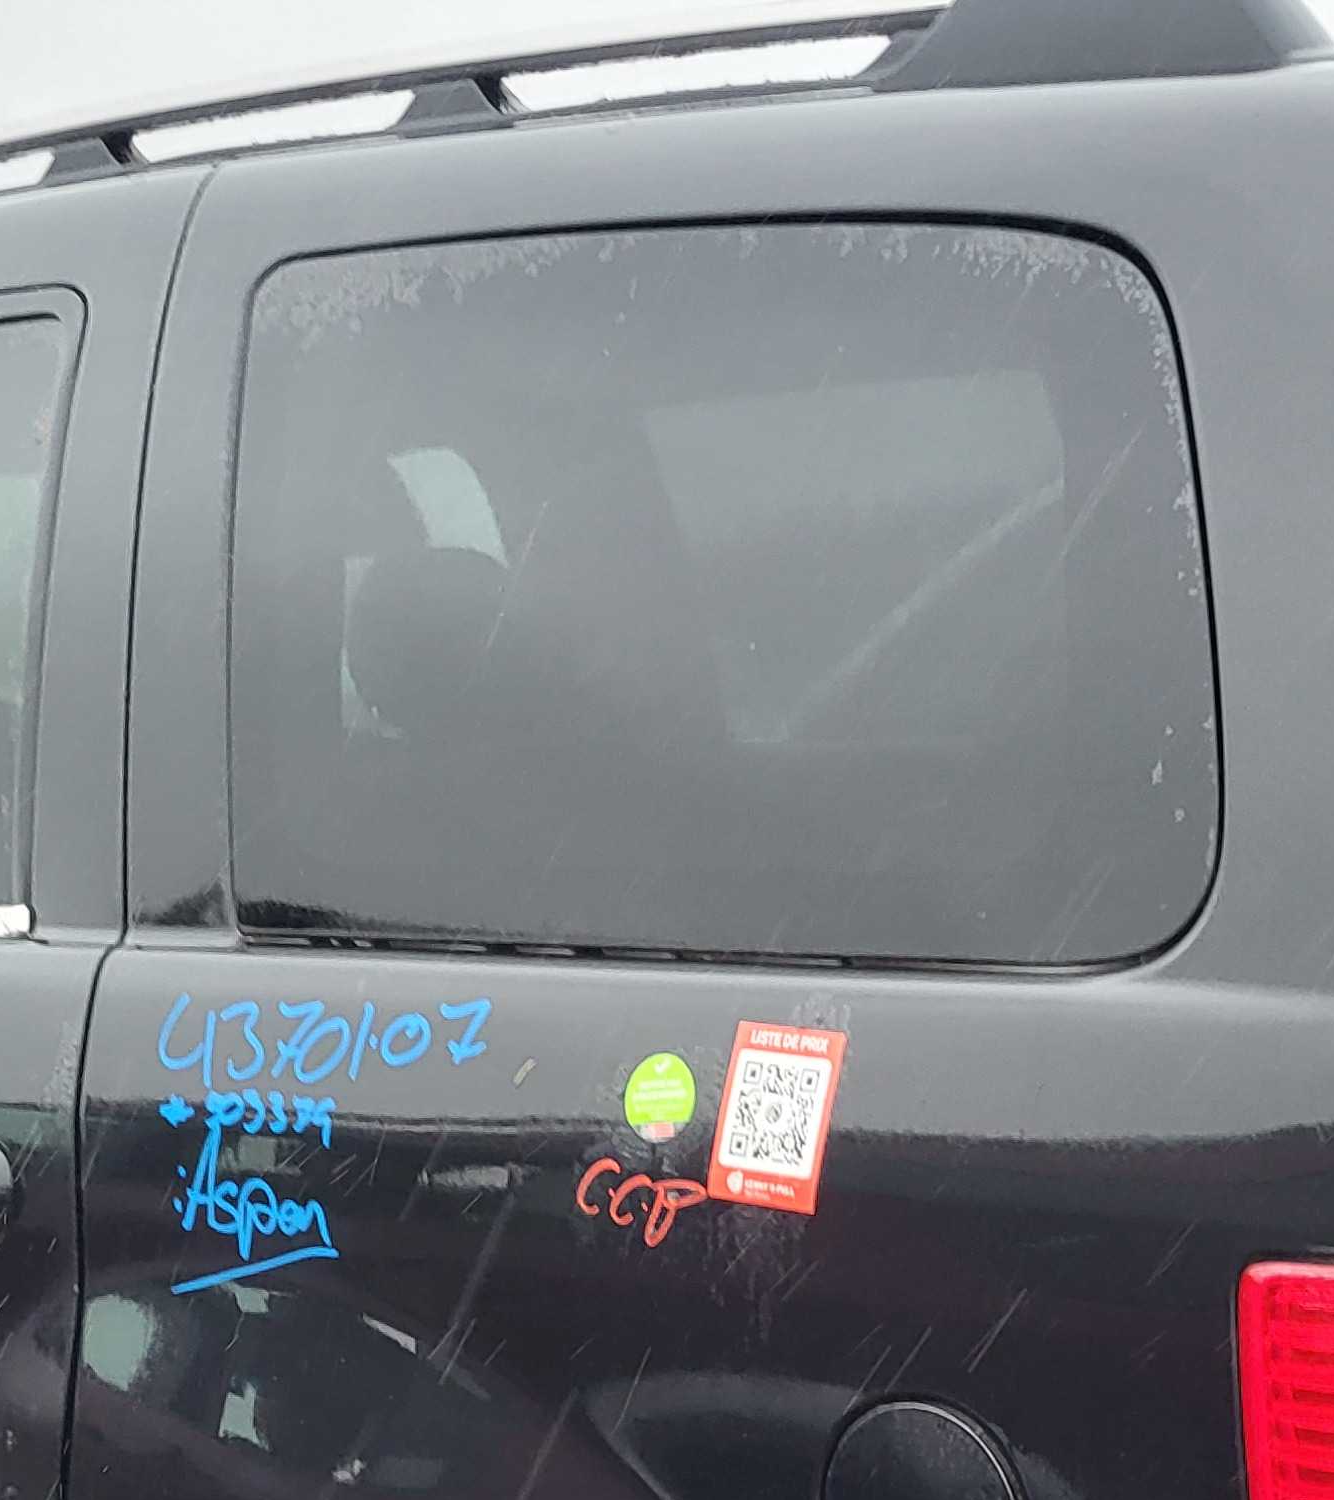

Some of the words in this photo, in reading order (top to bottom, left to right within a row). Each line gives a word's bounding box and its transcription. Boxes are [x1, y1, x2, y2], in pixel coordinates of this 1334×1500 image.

[749, 1028, 782, 1048] LISTE
[782, 1032, 800, 1050] DE
[799, 1034, 830, 1053] PRIX
